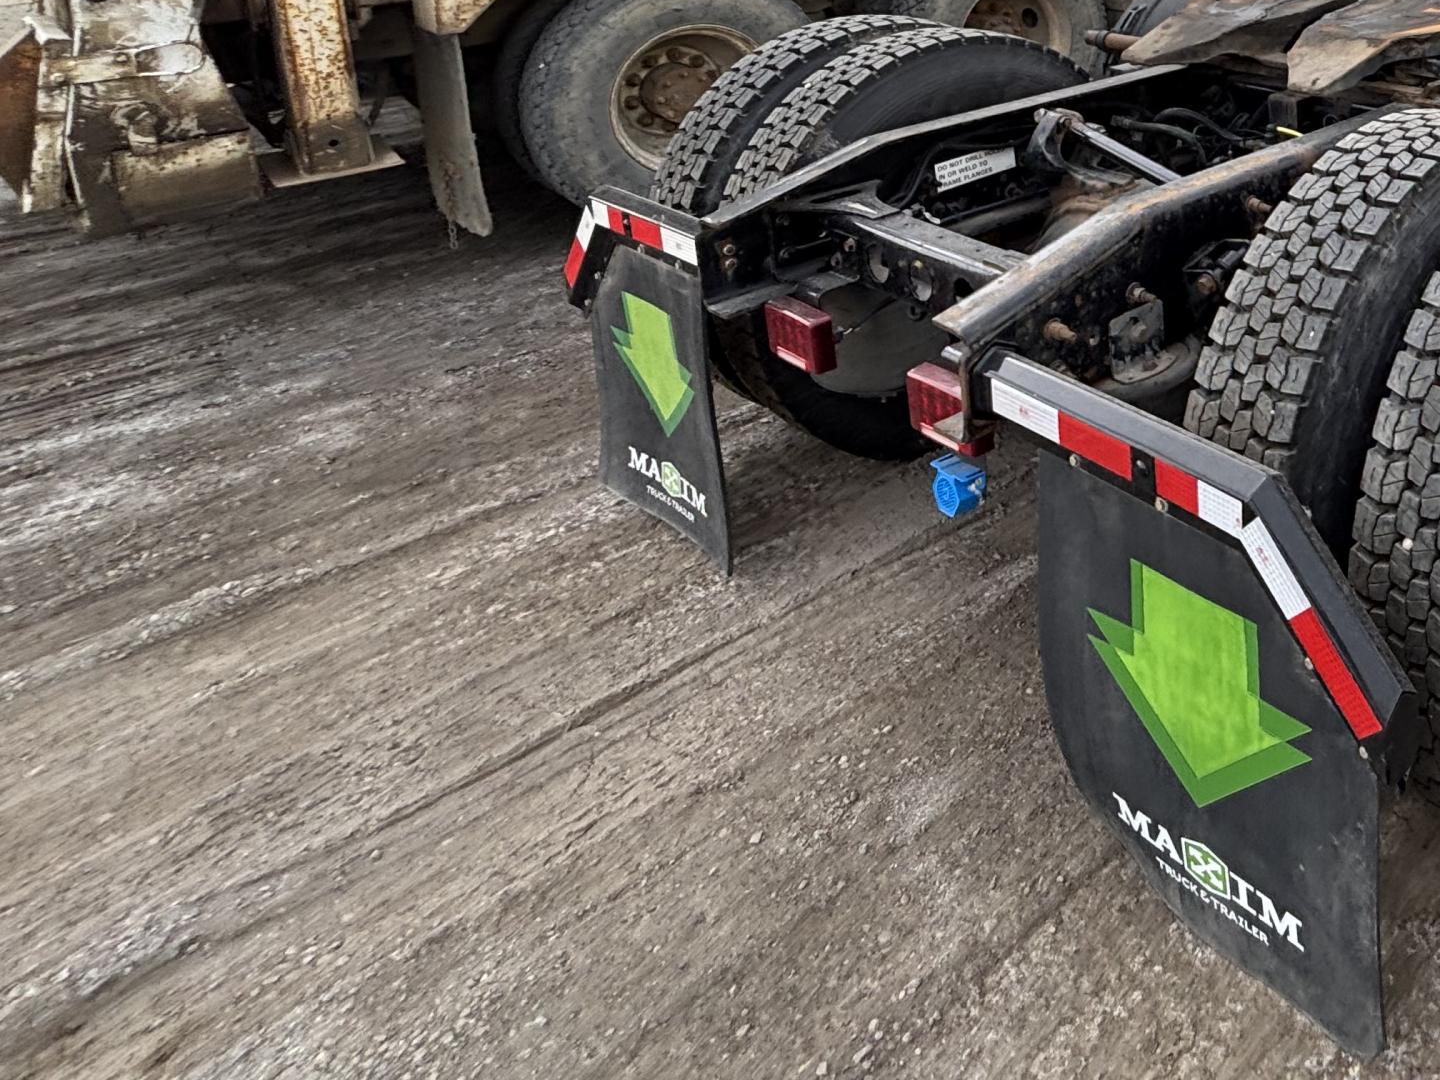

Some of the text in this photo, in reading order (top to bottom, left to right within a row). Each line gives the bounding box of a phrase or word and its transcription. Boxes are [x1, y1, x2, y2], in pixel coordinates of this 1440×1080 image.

[937, 164, 947, 172] DO
[949, 159, 963, 167] NOT
[938, 173, 946, 181] IN
[958, 163, 977, 173] WELD
[940, 178, 962, 187] RAME
[1112, 791, 1305, 953] MAXIM
[1155, 855, 1270, 947] TRUCK & TRAILER
